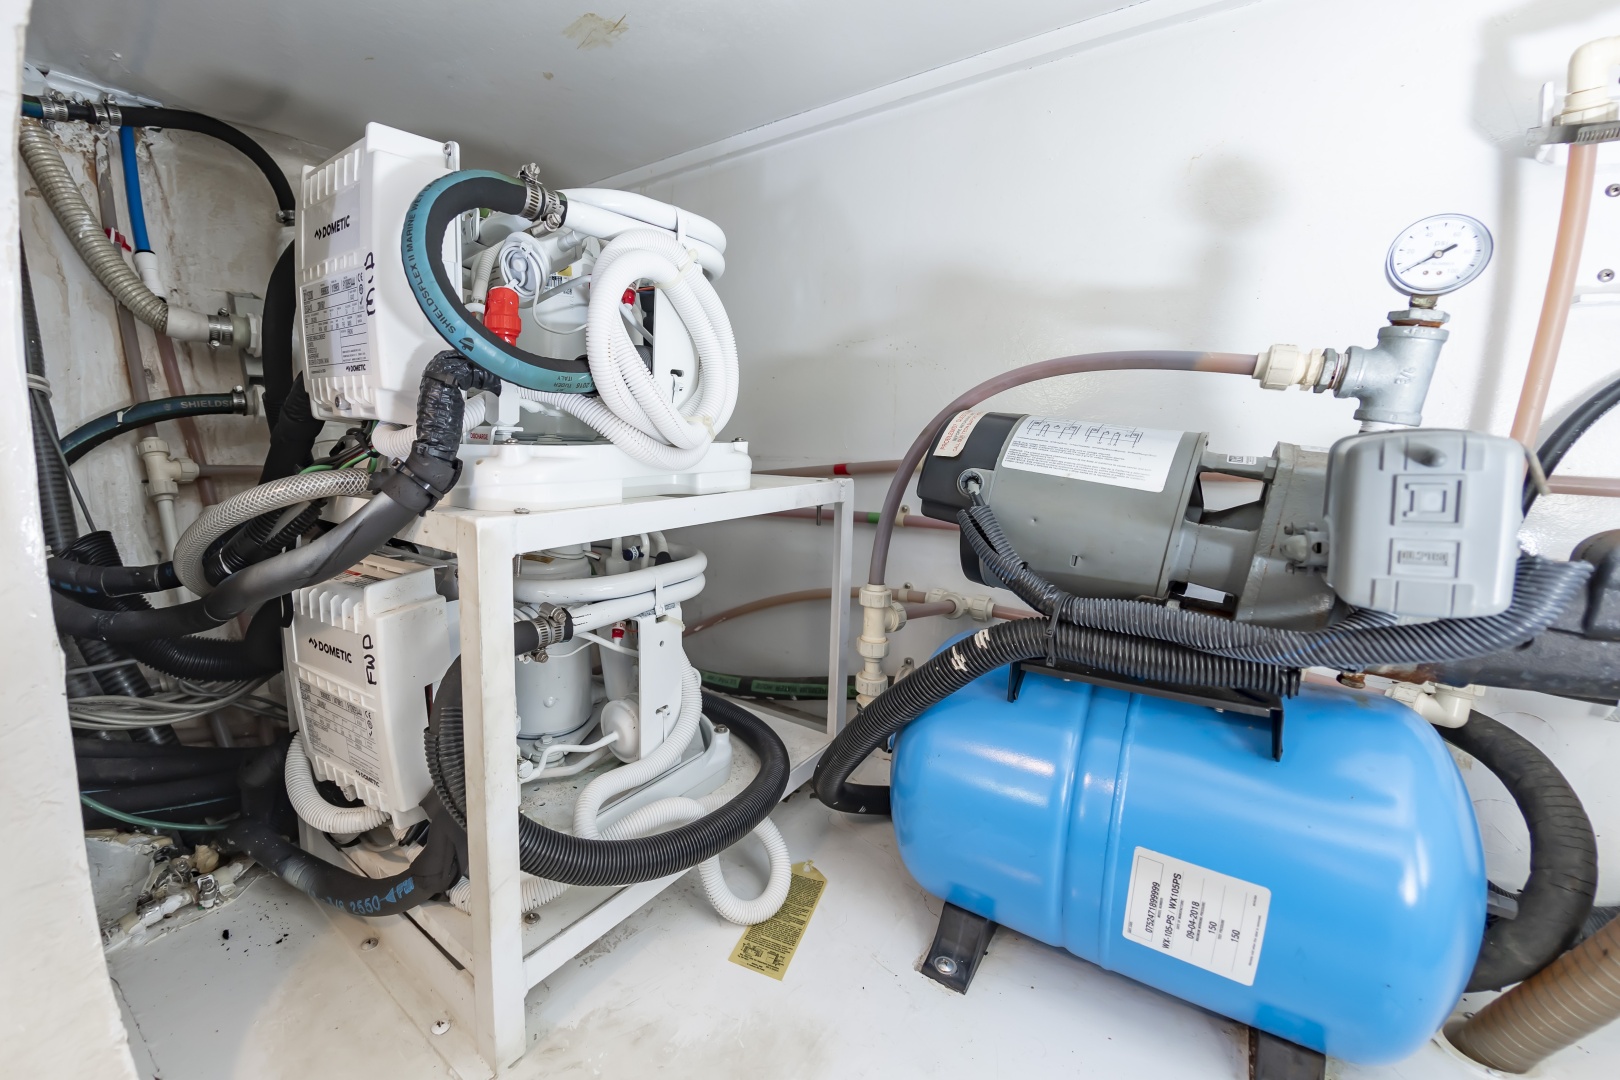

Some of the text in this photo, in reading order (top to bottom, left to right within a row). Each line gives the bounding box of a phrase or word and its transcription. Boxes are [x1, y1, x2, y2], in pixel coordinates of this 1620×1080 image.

[322, 215, 350, 239] DOMETIC
[406, 213, 416, 253] MARINE
[408, 254, 416, 262] II
[410, 263, 456, 334] SHIELDSFLEX
[351, 364, 366, 372] DOMETIC
[470, 432, 489, 440] DISCHARGE
[318, 641, 352, 664] DOMETIC
[362, 634, 377, 685] FWD
[360, 772, 380, 788] DOMETIC
[1168, 872, 1182, 910] WX105PS
[349, 895, 381, 914] 2550
[1145, 881, 1160, 934] 0752471899999
[1162, 914, 1175, 949] WX-105-PS
[1186, 901, 1200, 940] 09-04-2018
[1208, 920, 1217, 934] 150
[1230, 929, 1240, 943] 150
